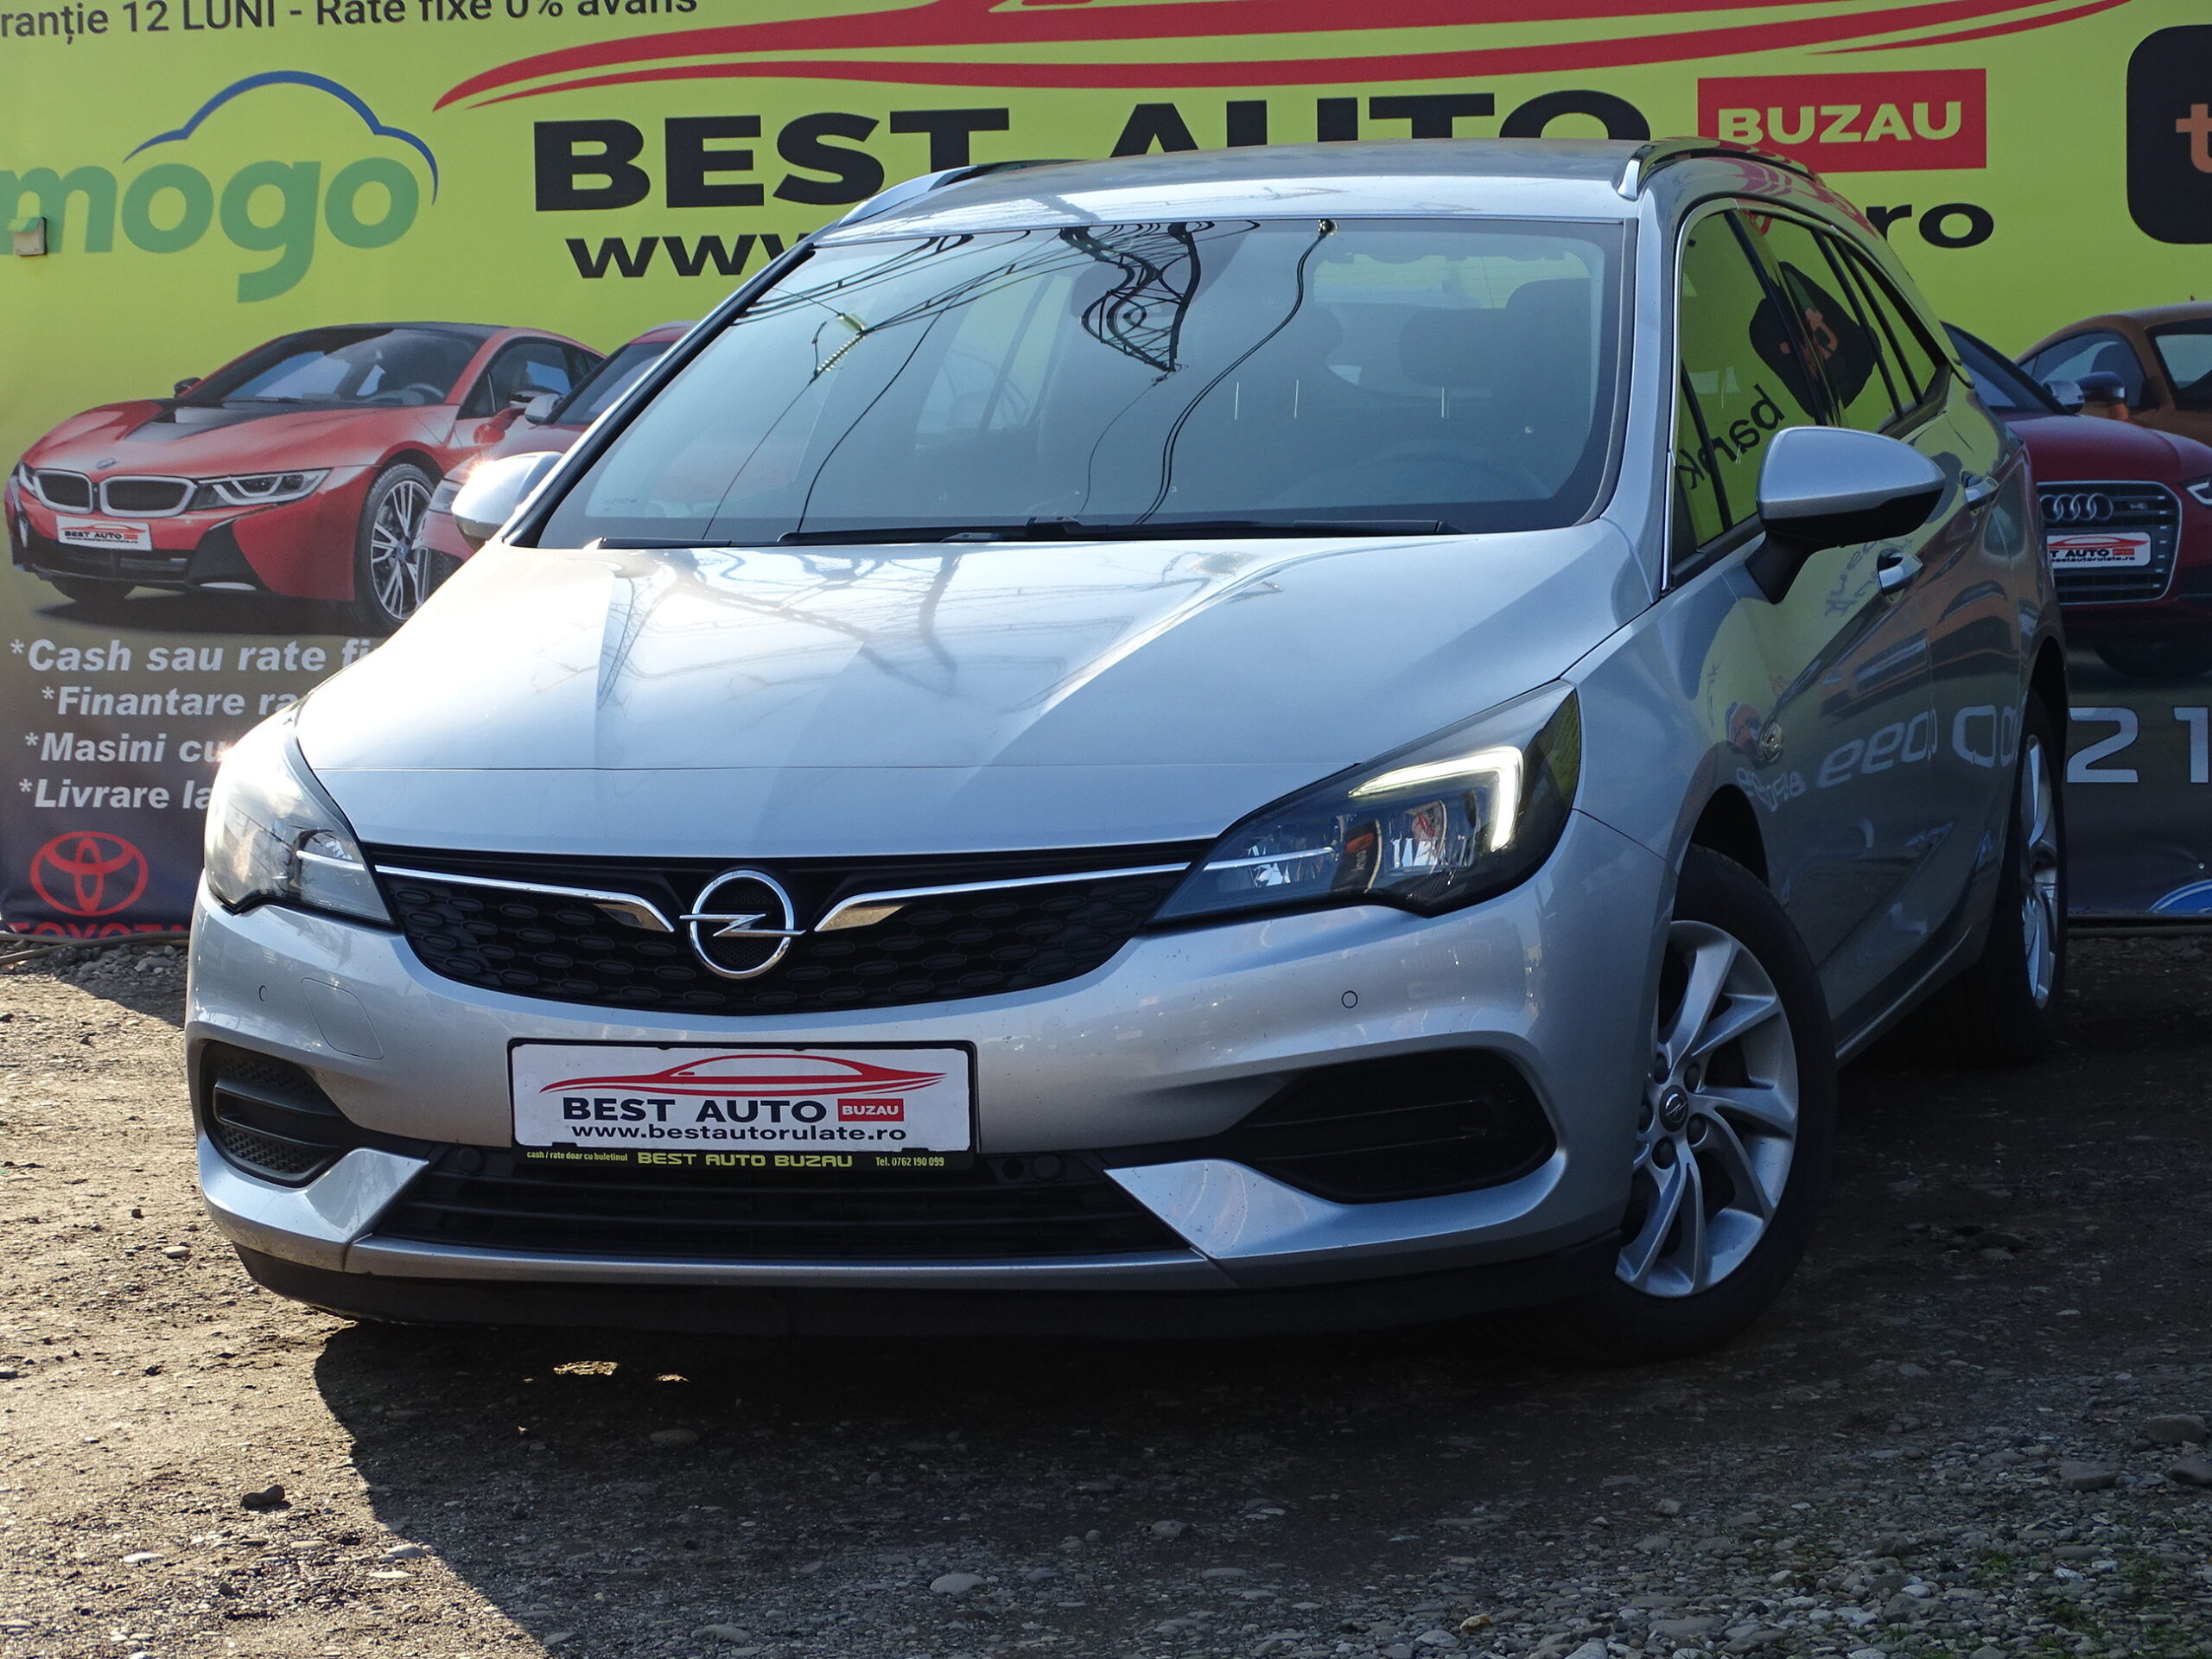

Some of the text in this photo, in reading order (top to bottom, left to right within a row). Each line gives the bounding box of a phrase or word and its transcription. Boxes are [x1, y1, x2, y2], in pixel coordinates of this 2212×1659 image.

[122, 1, 169, 32] 12
[183, 0, 276, 30] LUNI
[316, 0, 406, 25] Rate
[533, 107, 1010, 212] BEST
[1718, 101, 1962, 145] BUZAU
[0, 156, 420, 303] mogo
[2064, 549, 2110, 557] AUTO
[146, 646, 223, 671] sau
[238, 641, 327, 671] rate
[563, 1096, 899, 1123] BEST AUTO BUZAU
[571, 1123, 906, 1141] www.bestautorulate.ro
[637, 1152, 696, 1165] BEST
[705, 1154, 766, 1166] AUTO
[774, 1155, 853, 1167] BUZAU
[875, 1156, 890, 1166] Tel.
[892, 1156, 912, 1166] 0762
[913, 1157, 927, 1166] 190
[929, 1157, 944, 1166] 099
